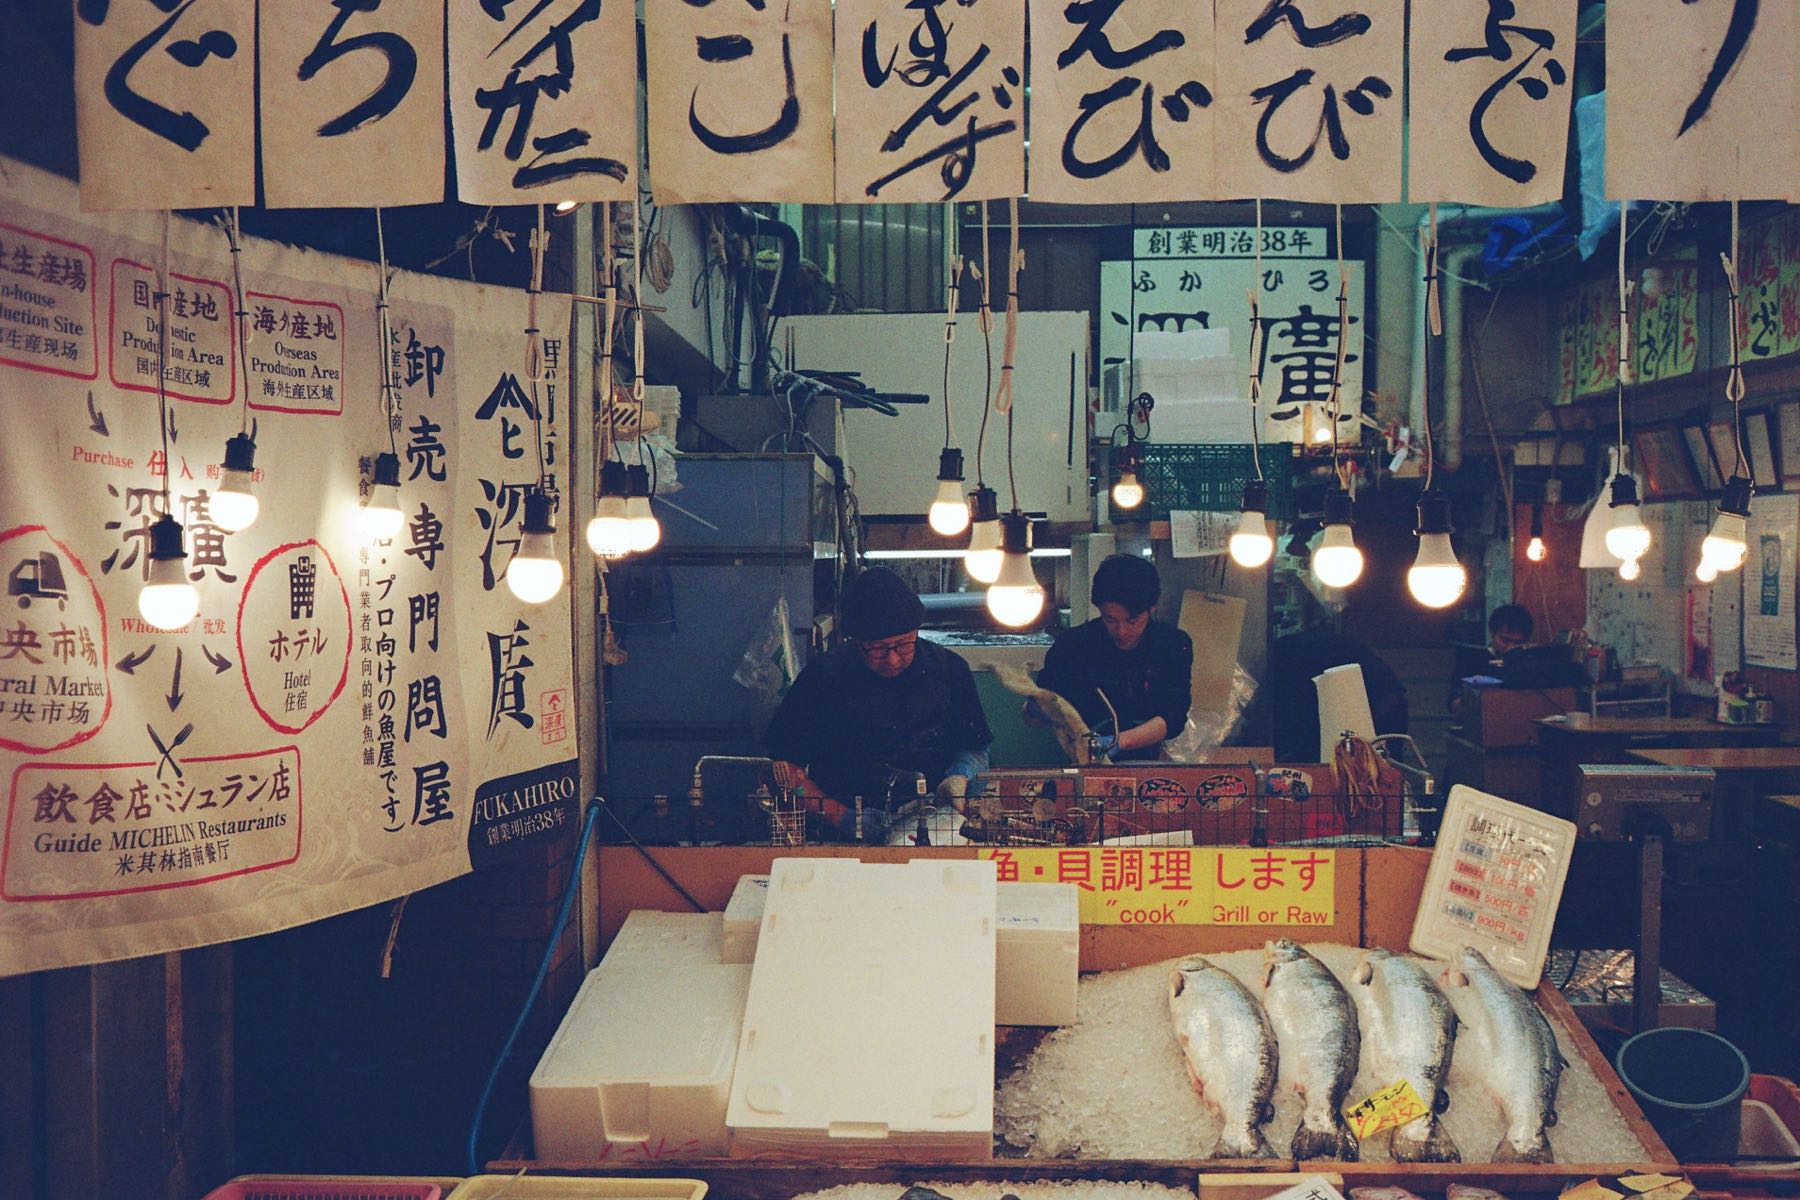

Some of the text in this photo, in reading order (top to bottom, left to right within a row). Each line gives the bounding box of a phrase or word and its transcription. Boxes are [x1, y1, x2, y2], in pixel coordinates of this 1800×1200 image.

[77, 0, 238, 152] ぐ
[1149, 230, 1313, 255] 創業明治38年
[0, 243, 87, 293] 生産場
[0, 303, 84, 337] uction Site
[253, 305, 337, 340] 海外産地
[187, 347, 225, 366] Area
[311, 365, 340, 380] Area
[72, 446, 134, 469] Purchase
[404, 328, 454, 827] 卸売専門問屋
[203, 618, 227, 635] 批发
[268, 628, 329, 663] ホテル
[45, 676, 105, 697] Market
[284, 669, 311, 690] Hotel
[284, 691, 308, 714] 住宿
[33, 759, 290, 825] 飲食店・ミシュラン店
[474, 776, 576, 826] FUKAHIRO
[34, 811, 287, 853] Guide MICHELIN Restaurants
[487, 807, 566, 846] 創業明治38年
[114, 839, 231, 876] 米其林指南餐厅
[1258, 911, 1279, 923] or
[1287, 905, 1328, 924] Raw
